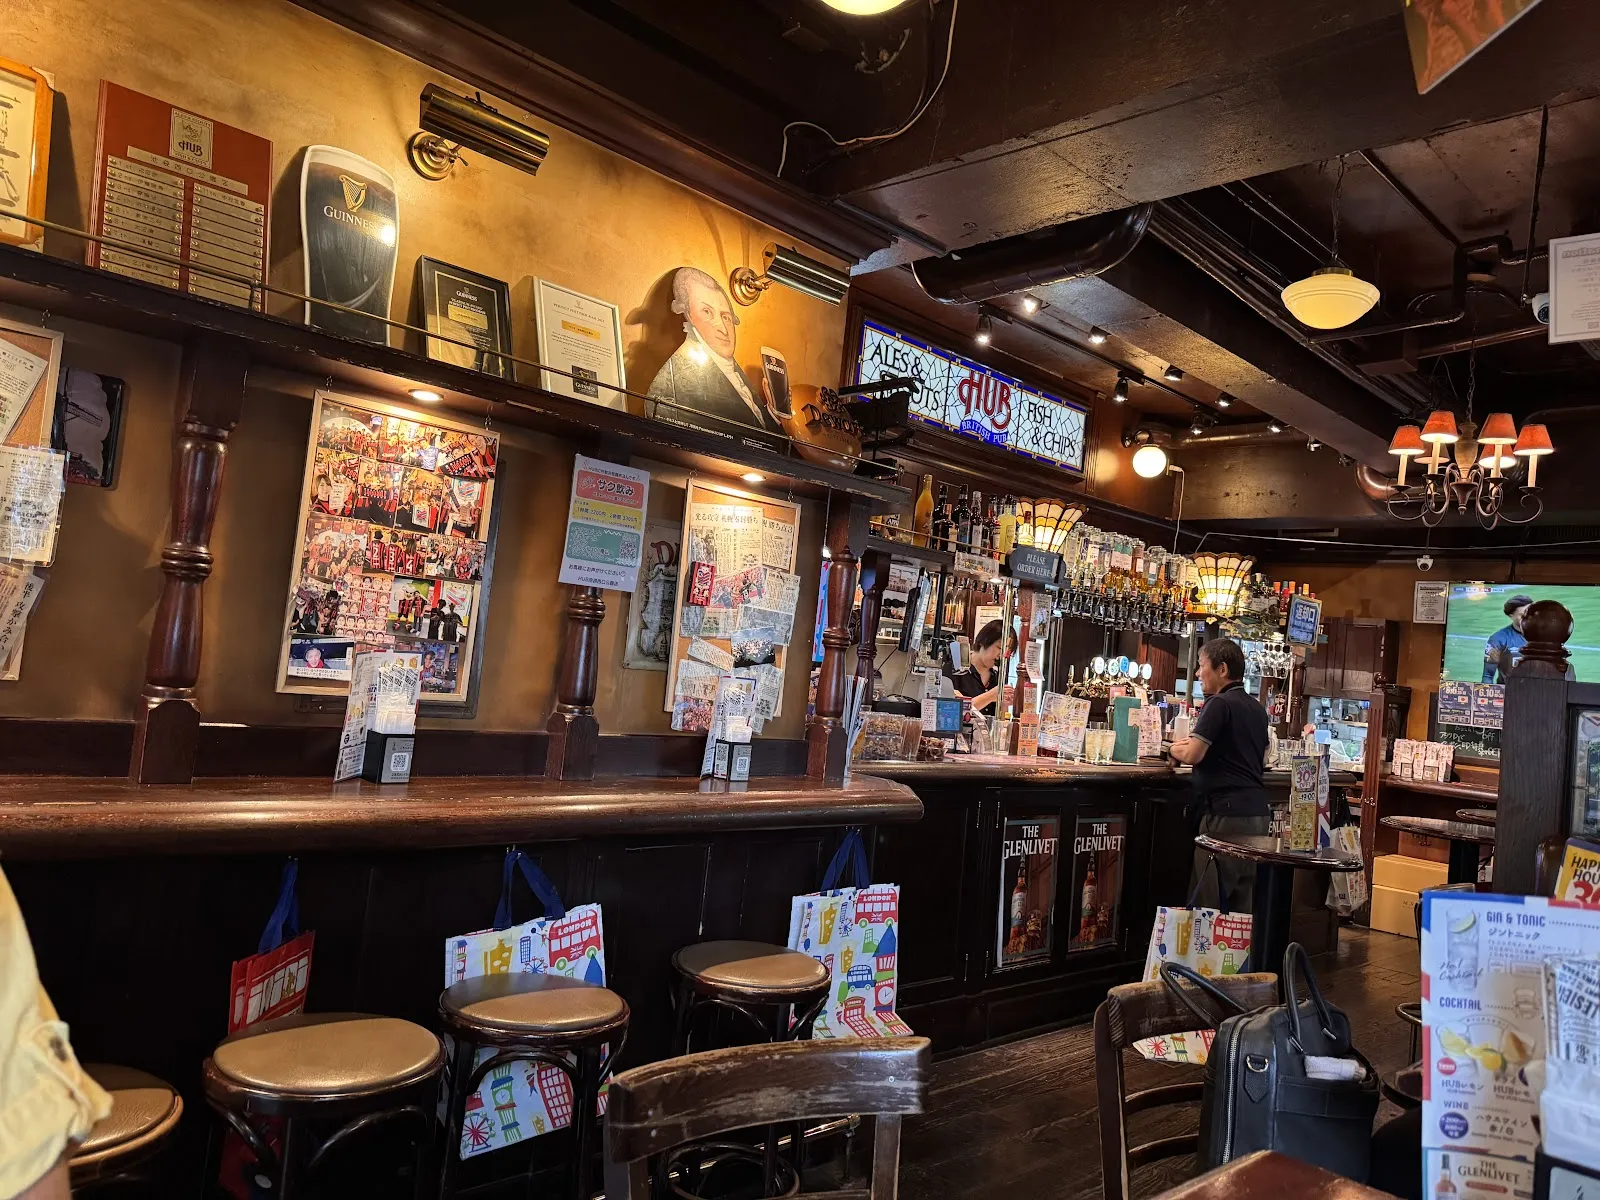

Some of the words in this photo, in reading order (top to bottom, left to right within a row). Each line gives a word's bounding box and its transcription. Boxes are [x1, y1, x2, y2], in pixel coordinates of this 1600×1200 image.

[178, 140, 203, 157] HUB
[870, 343, 909, 373] ALES
[911, 356, 925, 383] &
[958, 370, 1011, 431] HUB
[1027, 401, 1052, 428] FISH
[961, 420, 991, 441] BRITISH
[992, 431, 1008, 443] PUB
[1032, 427, 1042, 446] &
[1043, 431, 1076, 458] CHIPS
[597, 479, 635, 496] サク飲み
[1026, 553, 1046, 565] PLEASE
[1017, 563, 1036, 575] ORDER
[1035, 566, 1051, 578] HERE
[1479, 688, 1494, 698] 6.10
[1022, 825, 1040, 838] THE
[1092, 823, 1108, 835] THE
[1003, 838, 1058, 860] GLENLIVET
[1074, 835, 1125, 855] GLENLIVET
[863, 894, 892, 902] LONDON
[1221, 920, 1252, 930] LONDON
[1486, 911, 1503, 924] GIN
[1506, 912, 1512, 924] &
[1517, 913, 1546, 927] TONIC
[558, 919, 592, 936] LONDON
[1488, 927, 1540, 940] ジントニック
[1439, 996, 1482, 1011] COCKTAIL
[1442, 1079, 1484, 1091] HUBレモン
[1444, 1100, 1469, 1110] WINE
[1476, 1114, 1528, 1128] ハウスワイン
[1480, 1160, 1497, 1169] THE
[1457, 1165, 1520, 1185] GLENLIVET
